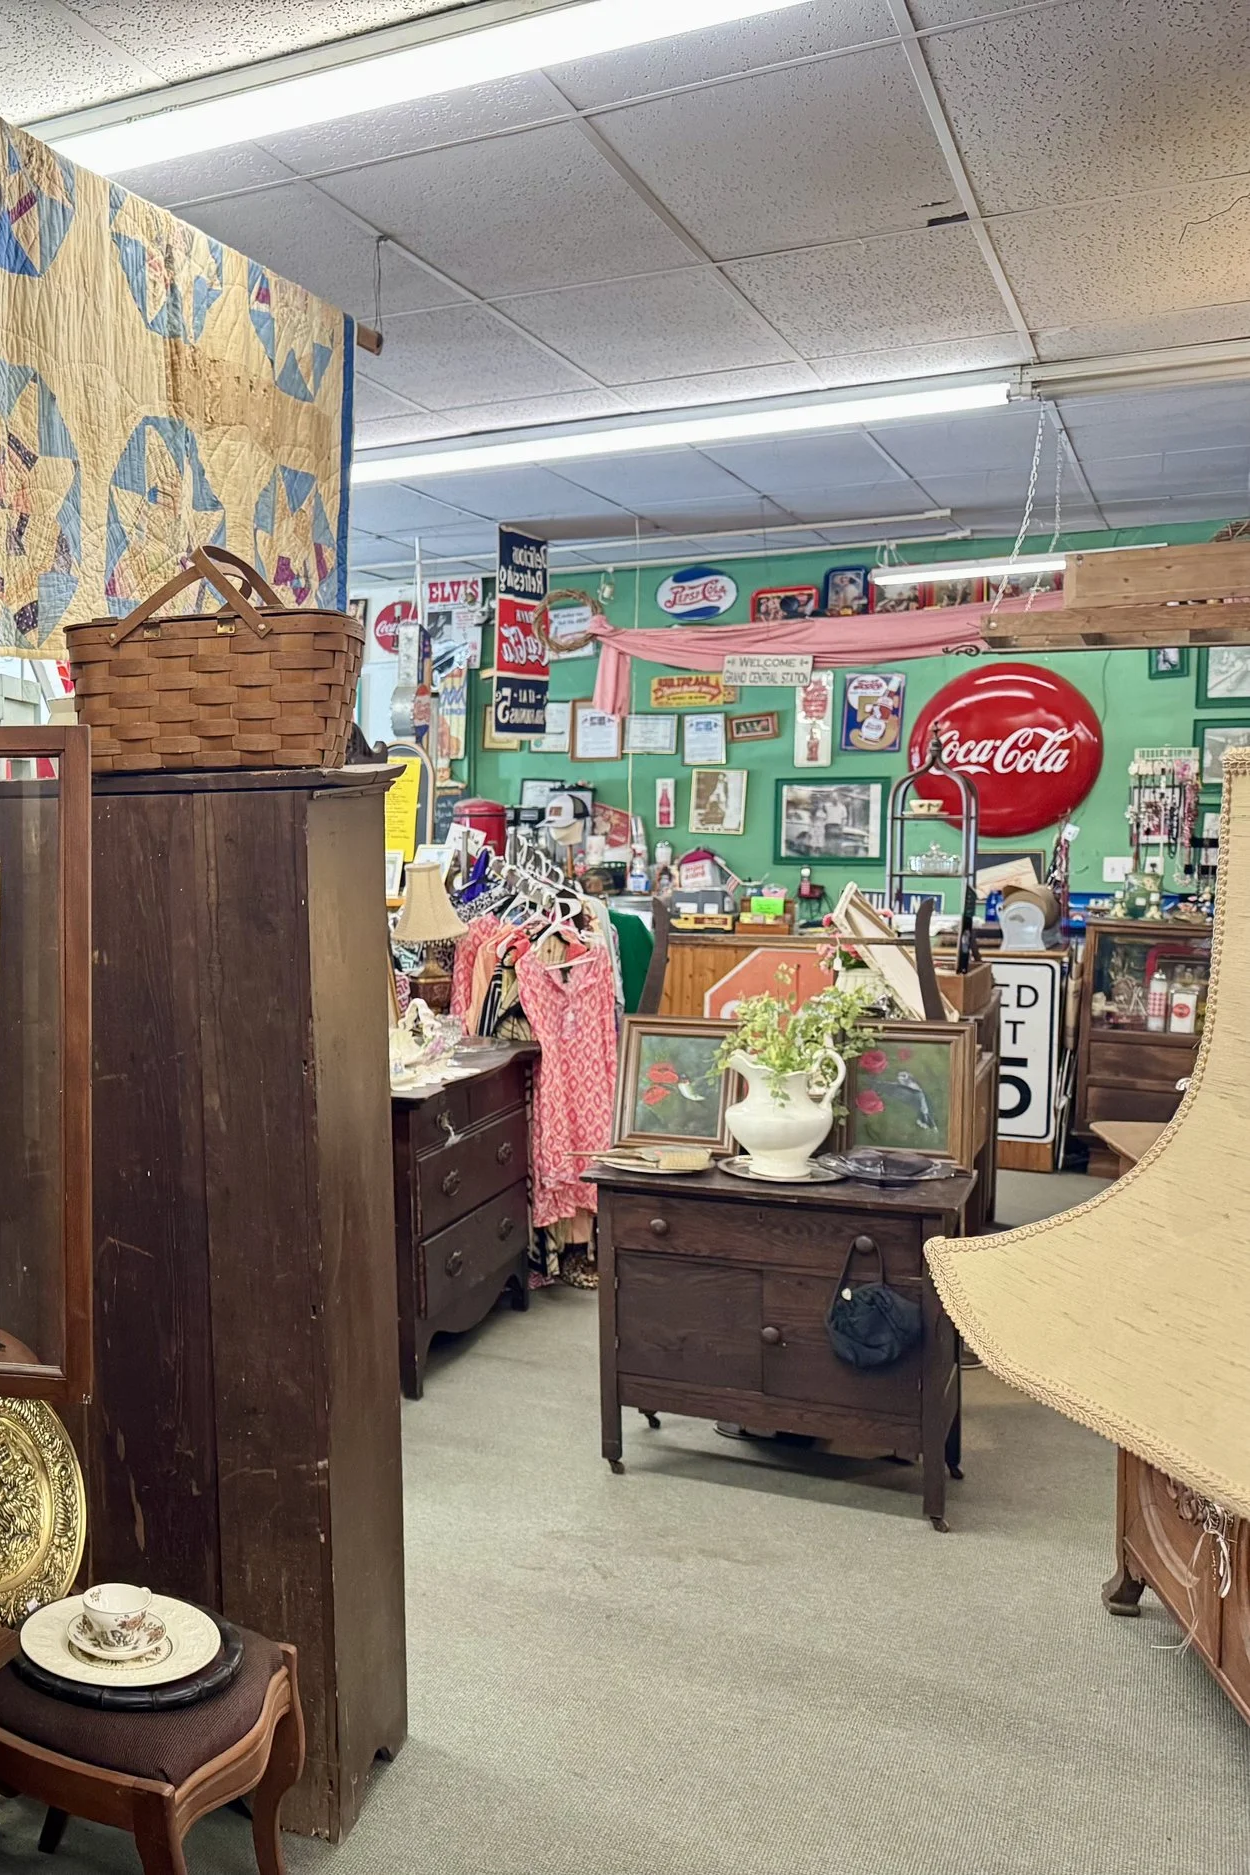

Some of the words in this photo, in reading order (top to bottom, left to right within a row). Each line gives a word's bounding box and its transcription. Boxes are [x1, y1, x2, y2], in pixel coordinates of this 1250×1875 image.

[739, 656, 796, 670] WELCOME
[724, 669, 746, 684] GRAND
[749, 670, 777, 684] CENTRAL
[781, 670, 809, 684] STATION
[928, 727, 1077, 775] Coca-Cola
